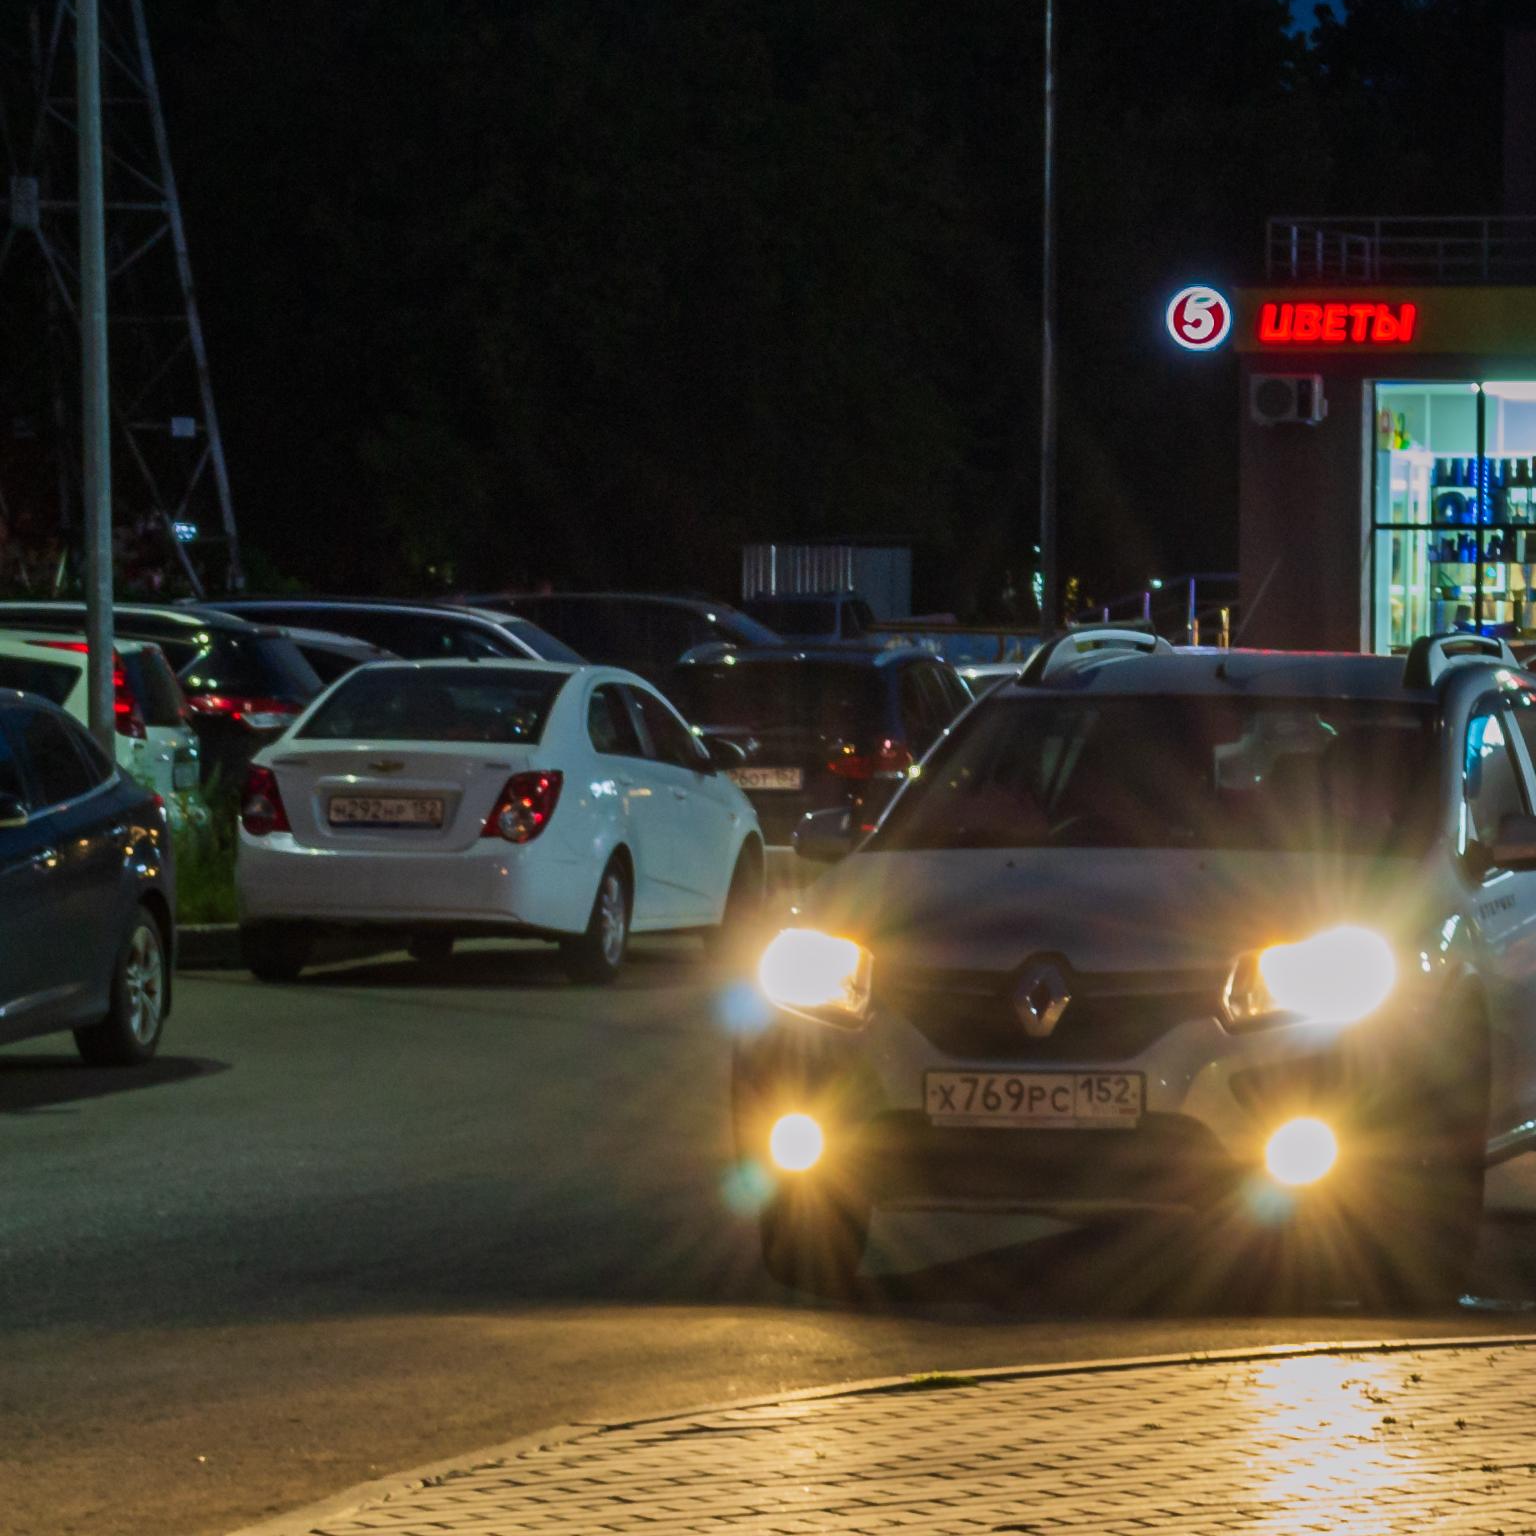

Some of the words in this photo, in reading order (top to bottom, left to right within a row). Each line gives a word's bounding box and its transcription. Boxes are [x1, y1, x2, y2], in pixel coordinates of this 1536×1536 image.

[1258, 302, 1416, 344] ЦВЕТЫ
[938, 1077, 1071, 1113] Х769РС
[1079, 1077, 1130, 1103] 152
